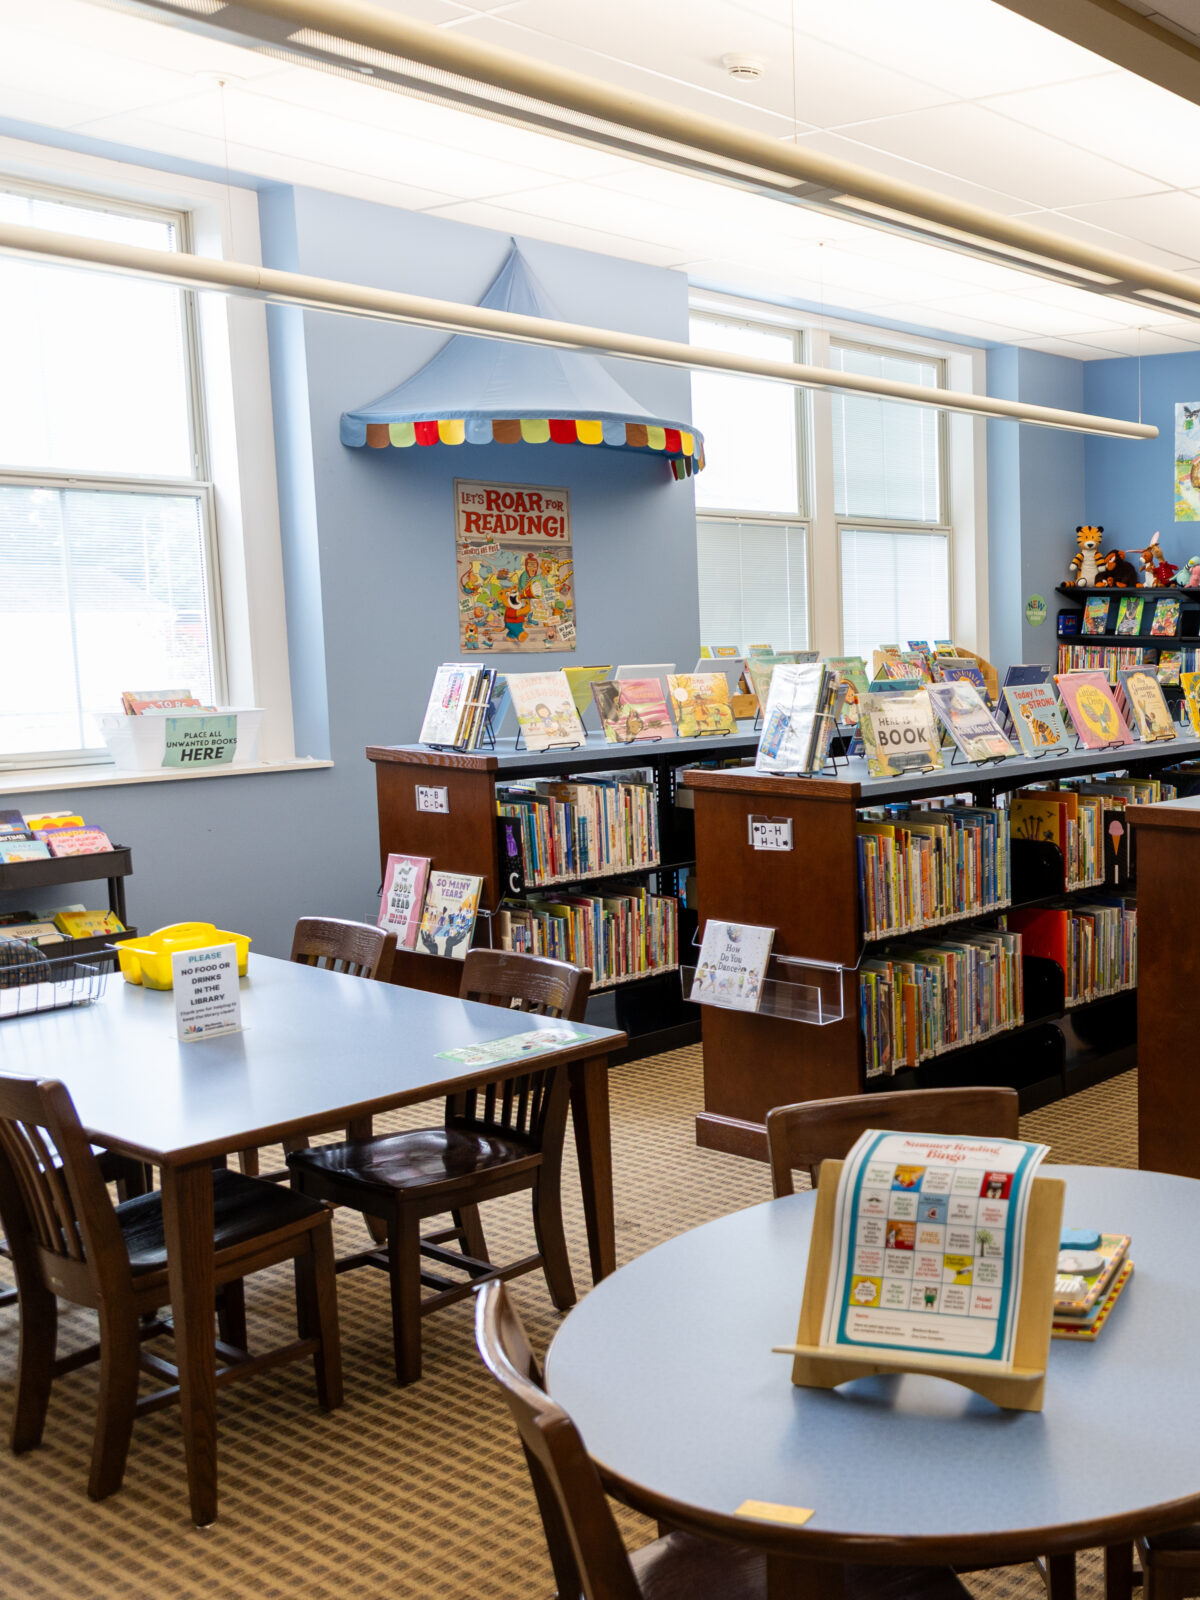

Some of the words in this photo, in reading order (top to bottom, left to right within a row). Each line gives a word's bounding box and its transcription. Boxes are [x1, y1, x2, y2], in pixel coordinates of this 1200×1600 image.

[461, 492, 485, 505] LET'S
[483, 489, 544, 513] ROAR
[545, 499, 564, 512] FOR
[462, 510, 565, 538] READING!
[1013, 690, 1033, 700] Today
[1034, 688, 1045, 697] I'm
[1028, 697, 1055, 709] STRONG
[184, 731, 208, 739] PLACE
[878, 728, 927, 746] BOOK
[166, 739, 210, 748] UNWANTED
[211, 737, 238, 746] BOOKS
[180, 746, 225, 762] HERE
[424, 791, 429, 799] A
[424, 800, 429, 808] C
[760, 825, 767, 835] D
[774, 825, 782, 836] H
[761, 837, 768, 847] H
[775, 837, 781, 847] L
[436, 878, 447, 888] SO
[448, 880, 471, 891] MANY
[509, 871, 521, 893] C
[441, 887, 464, 899] YEARS
[391, 897, 410, 910] READ
[388, 913, 408, 926] MIND
[726, 943, 741, 954] How
[188, 951, 222, 963] PLEASE
[720, 952, 730, 962] Do
[730, 954, 743, 964] You
[181, 968, 194, 976] NO
[195, 964, 218, 974] FOOD
[218, 962, 231, 970] OR
[718, 962, 742, 973] Dance?
[191, 973, 222, 985] DRINKS
[204, 984, 221, 993] THE
[190, 993, 225, 1006] LIBRARY
[904, 1139, 953, 1151] Summer
[954, 1142, 1002, 1156] Reading
[926, 1149, 967, 1163] Bingo
